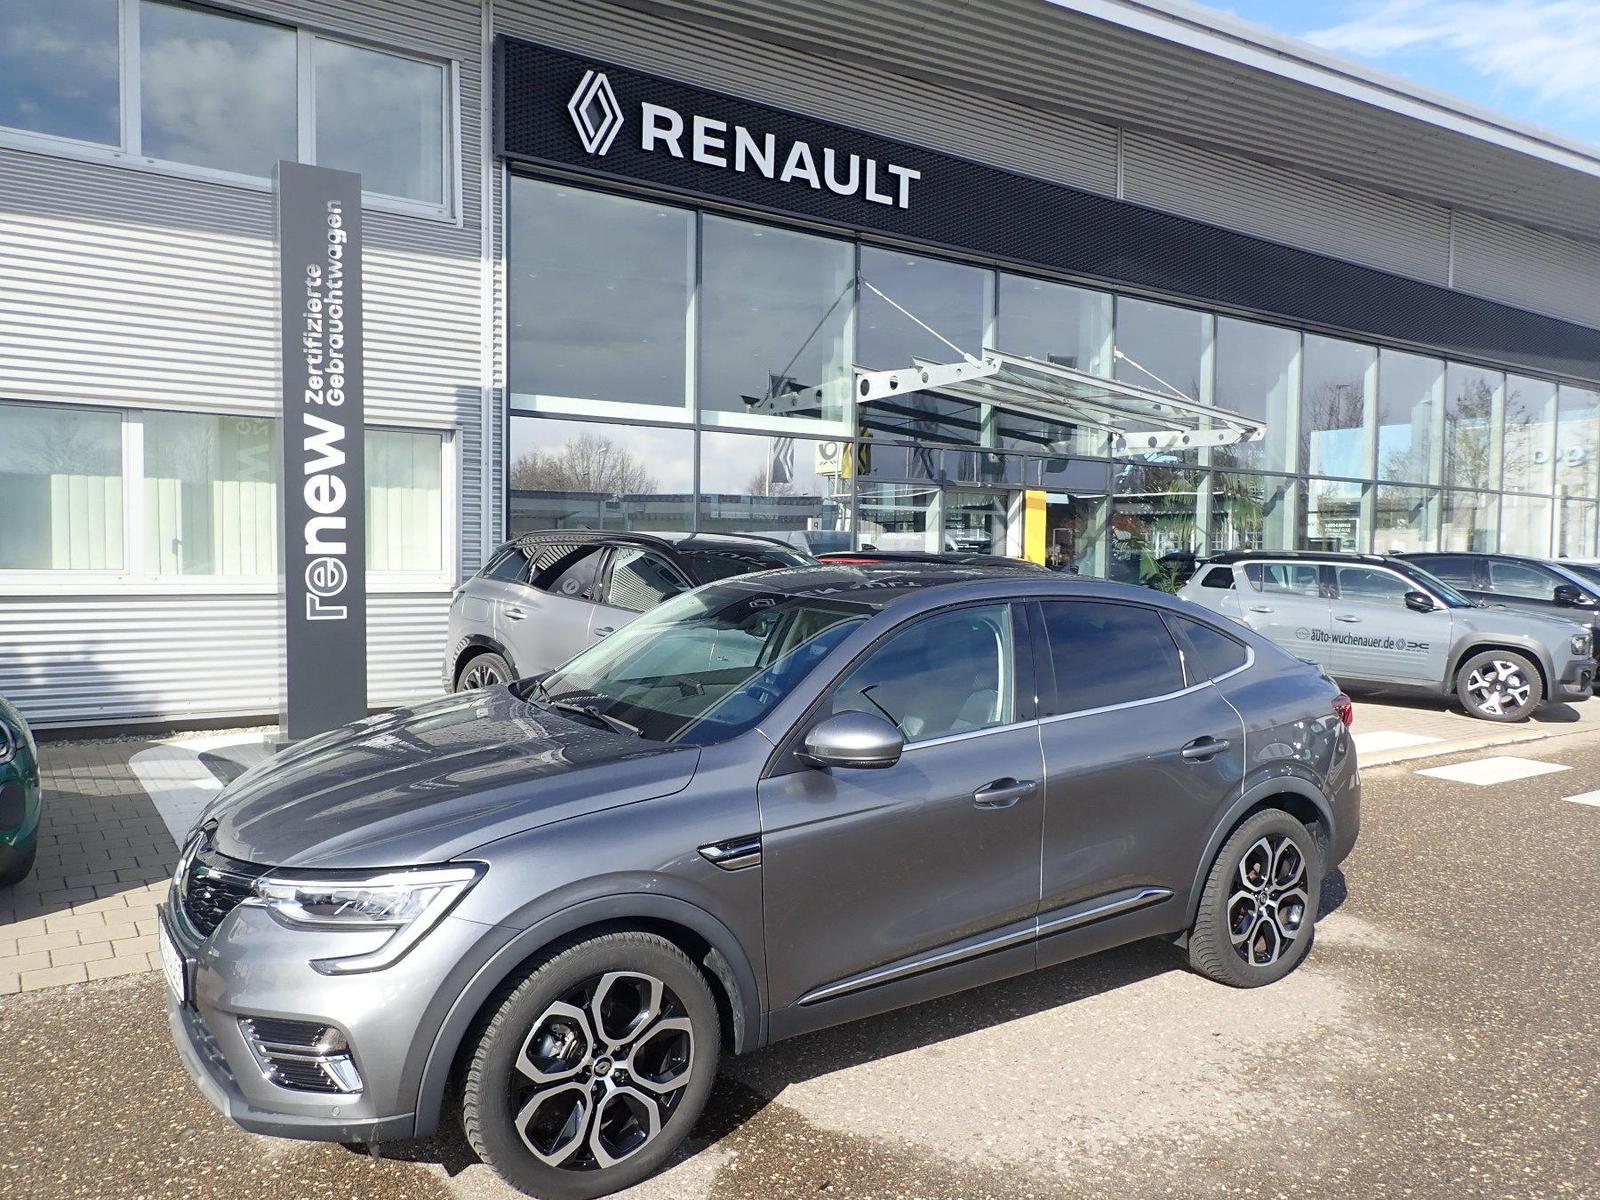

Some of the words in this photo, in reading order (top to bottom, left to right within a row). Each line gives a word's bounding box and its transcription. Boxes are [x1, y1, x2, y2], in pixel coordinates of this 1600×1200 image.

[642, 102, 920, 209] RENAULT
[303, 264, 323, 405] Zertifizierte
[324, 200, 347, 406] Gebrauchtwagen
[304, 414, 348, 621] renew
[1310, 631, 1394, 649] auto-wuchenauer.de
